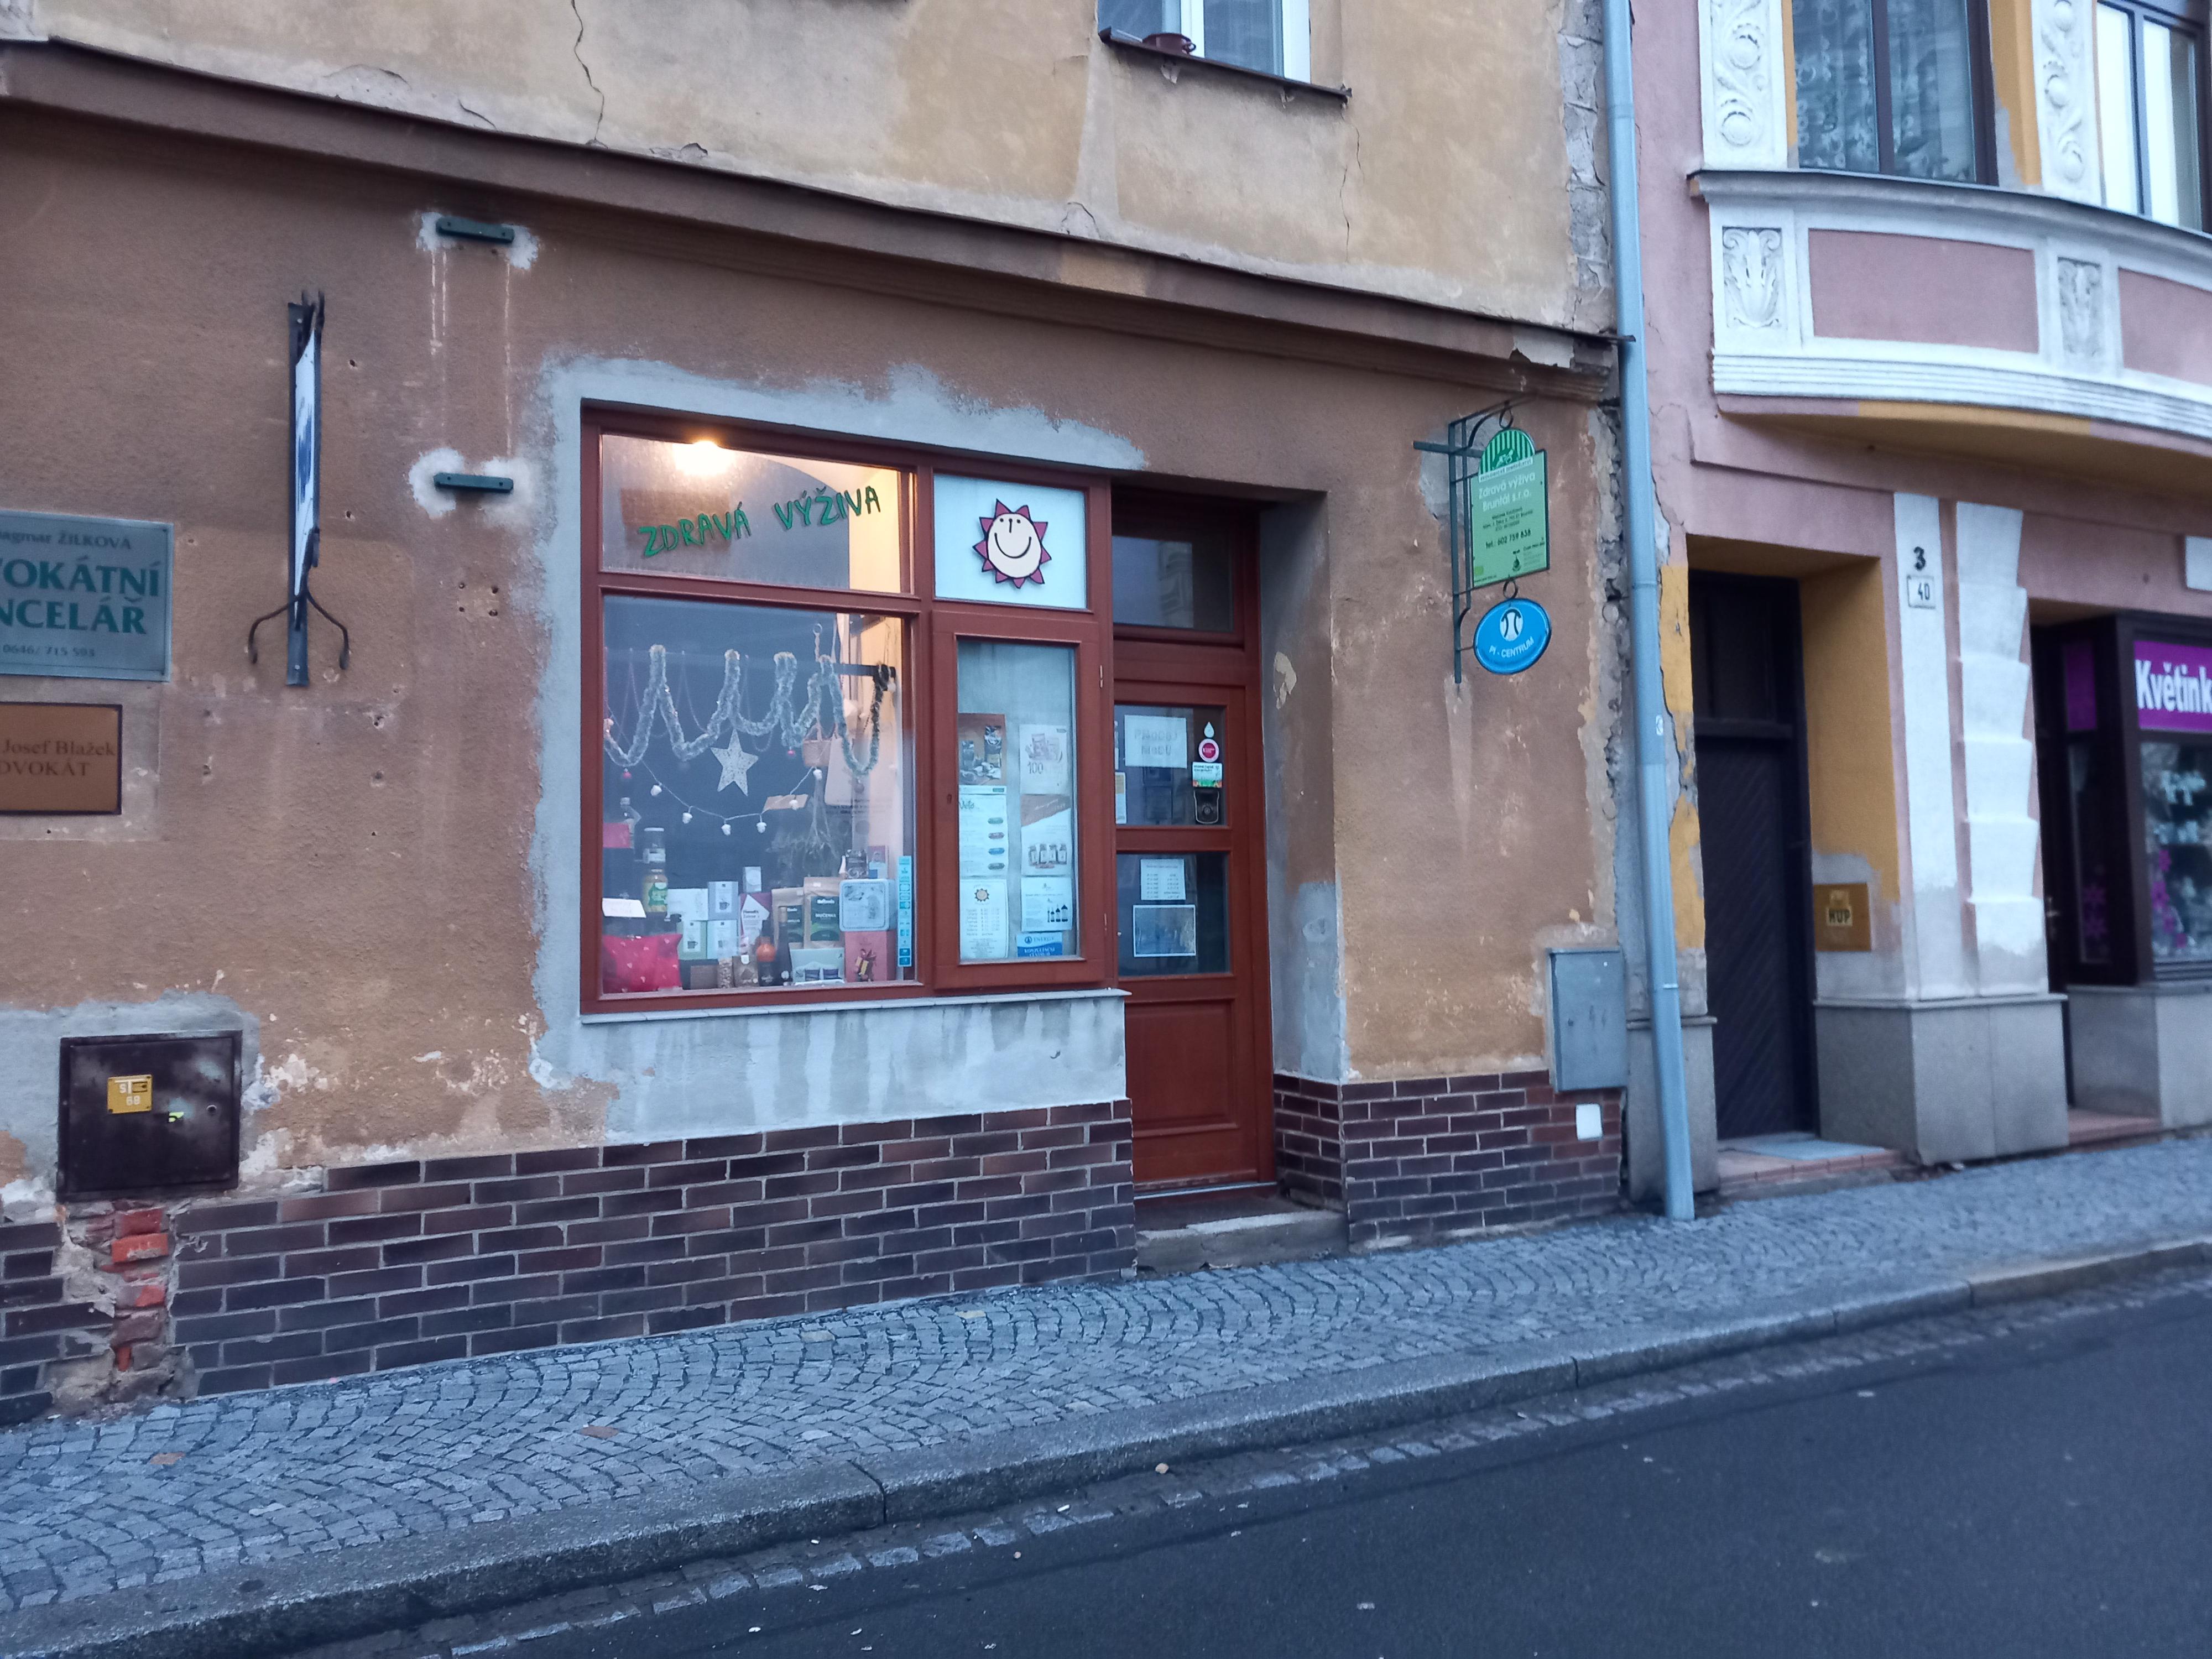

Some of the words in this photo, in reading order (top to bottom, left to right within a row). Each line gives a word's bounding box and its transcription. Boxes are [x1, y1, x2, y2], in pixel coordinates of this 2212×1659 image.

[638, 502, 752, 557] ZDRAVÁ
[774, 486, 881, 531] VÝŽIVA
[1913, 546, 1926, 571] 3
[0, 555, 161, 597] OKÁTNÍ
[1918, 582, 1931, 601] 40
[1501, 635, 1535, 658] CENTRUM
[2, 739, 51, 754] Josef
[55, 740, 117, 756] Blažek
